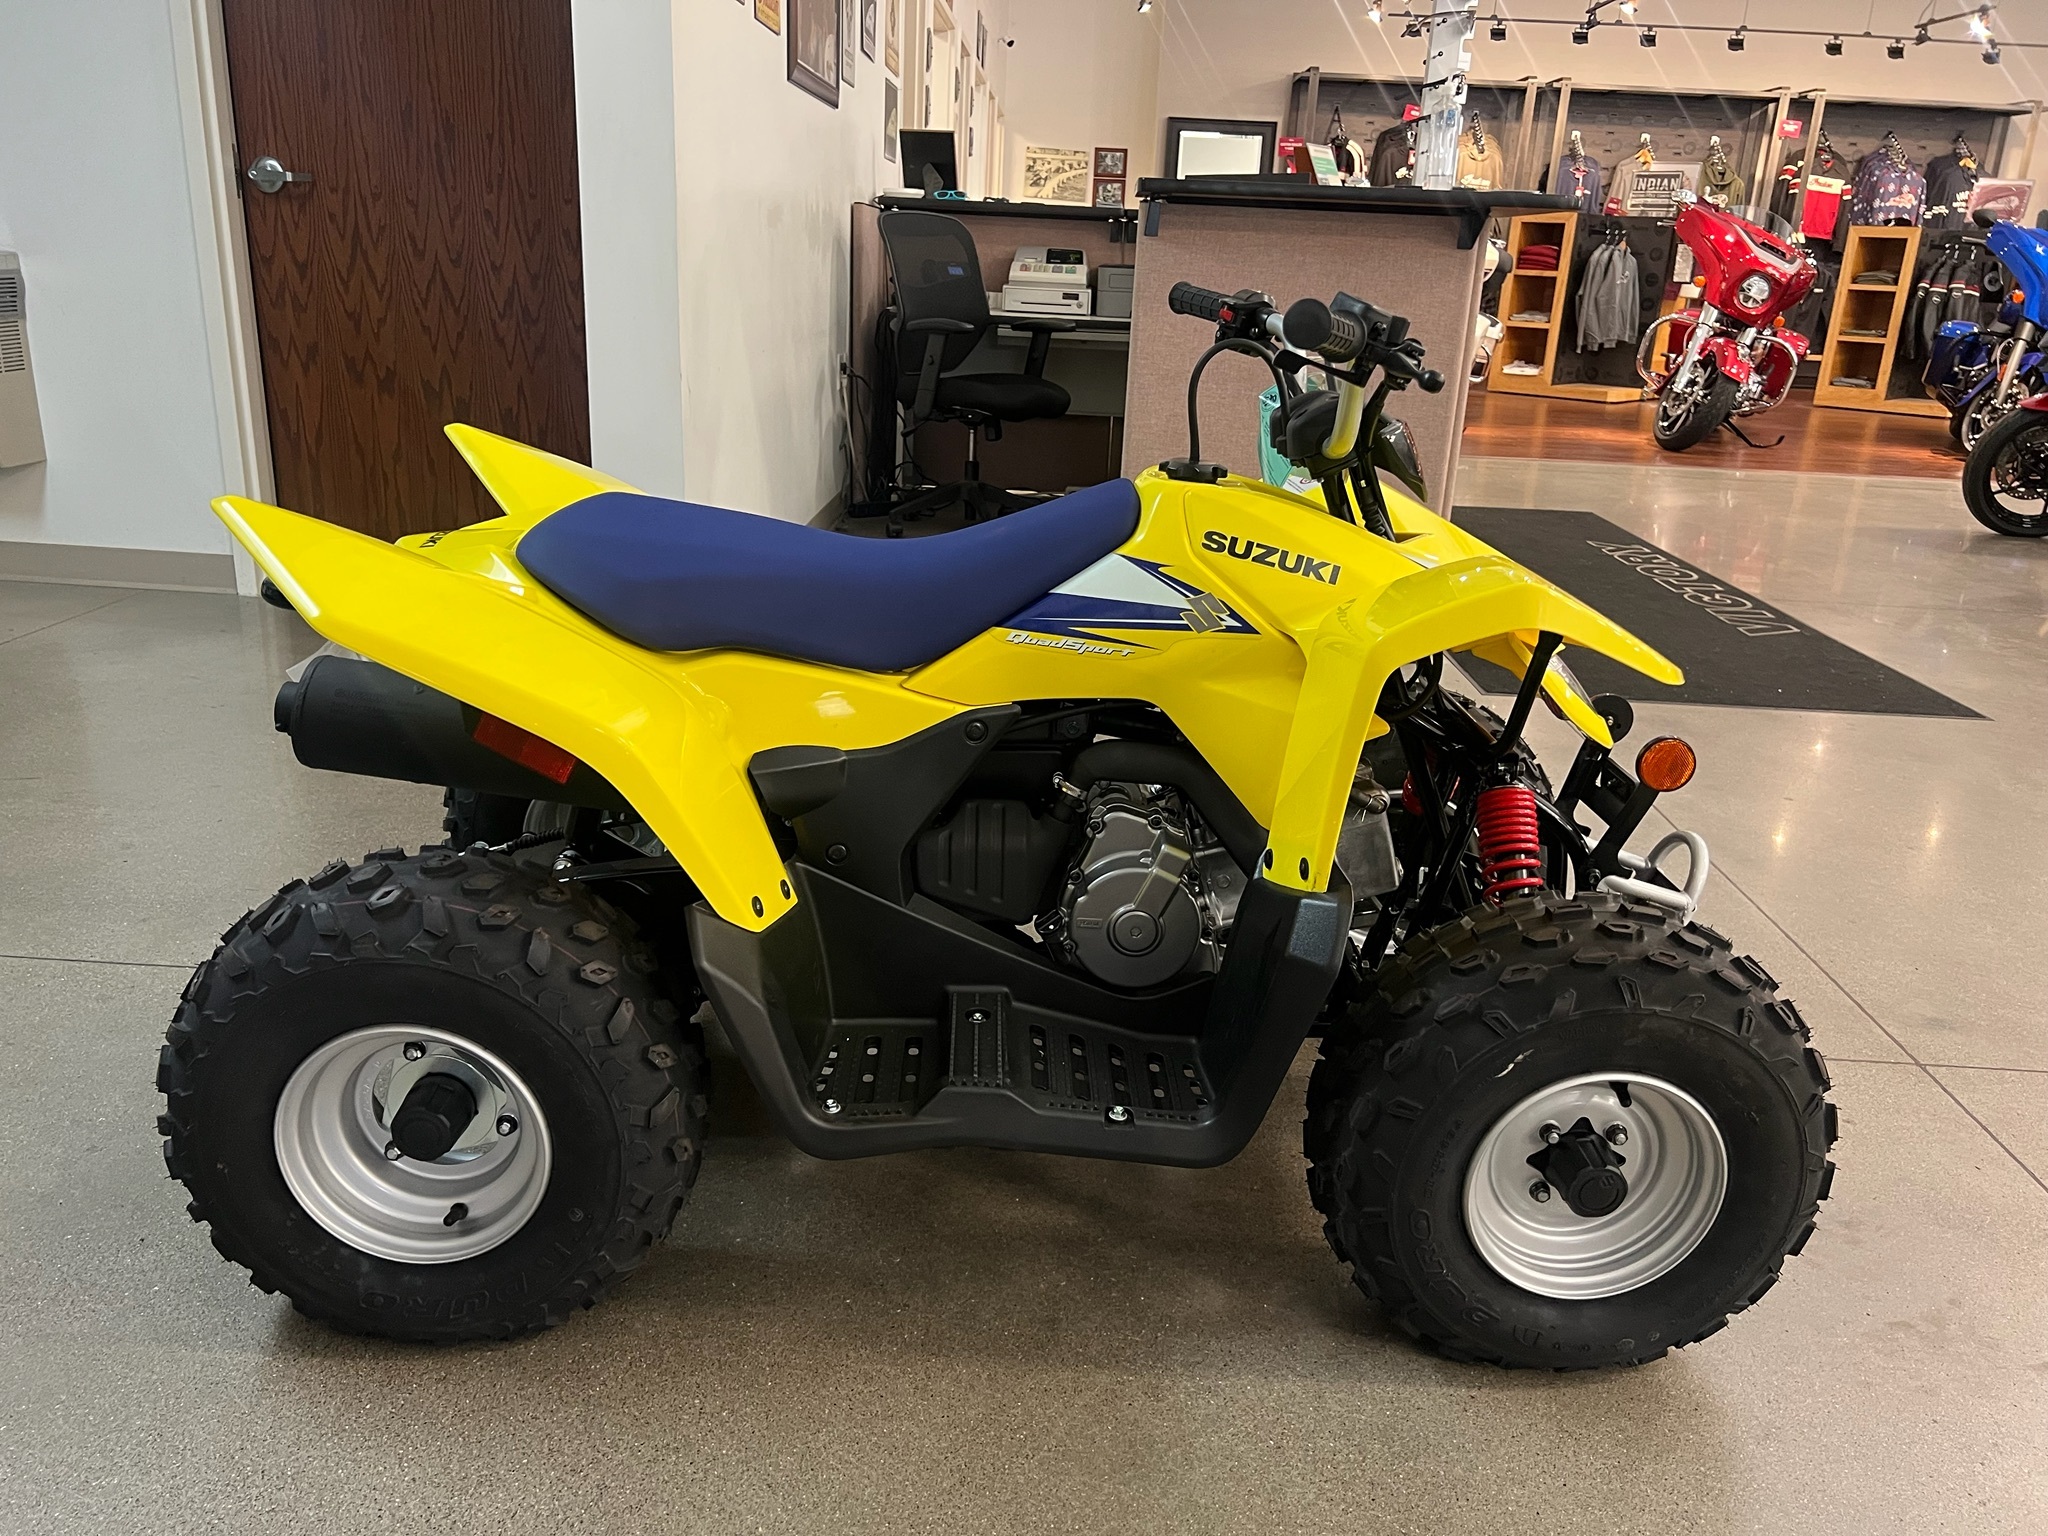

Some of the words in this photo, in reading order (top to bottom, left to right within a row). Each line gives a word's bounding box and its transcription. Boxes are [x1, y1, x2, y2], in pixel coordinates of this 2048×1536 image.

[1633, 177, 1679, 191] INDIAN
[1201, 530, 1342, 586] SUZUKI
[1586, 540, 1801, 637] VICTORY
[1005, 630, 1136, 658] QuadSport
